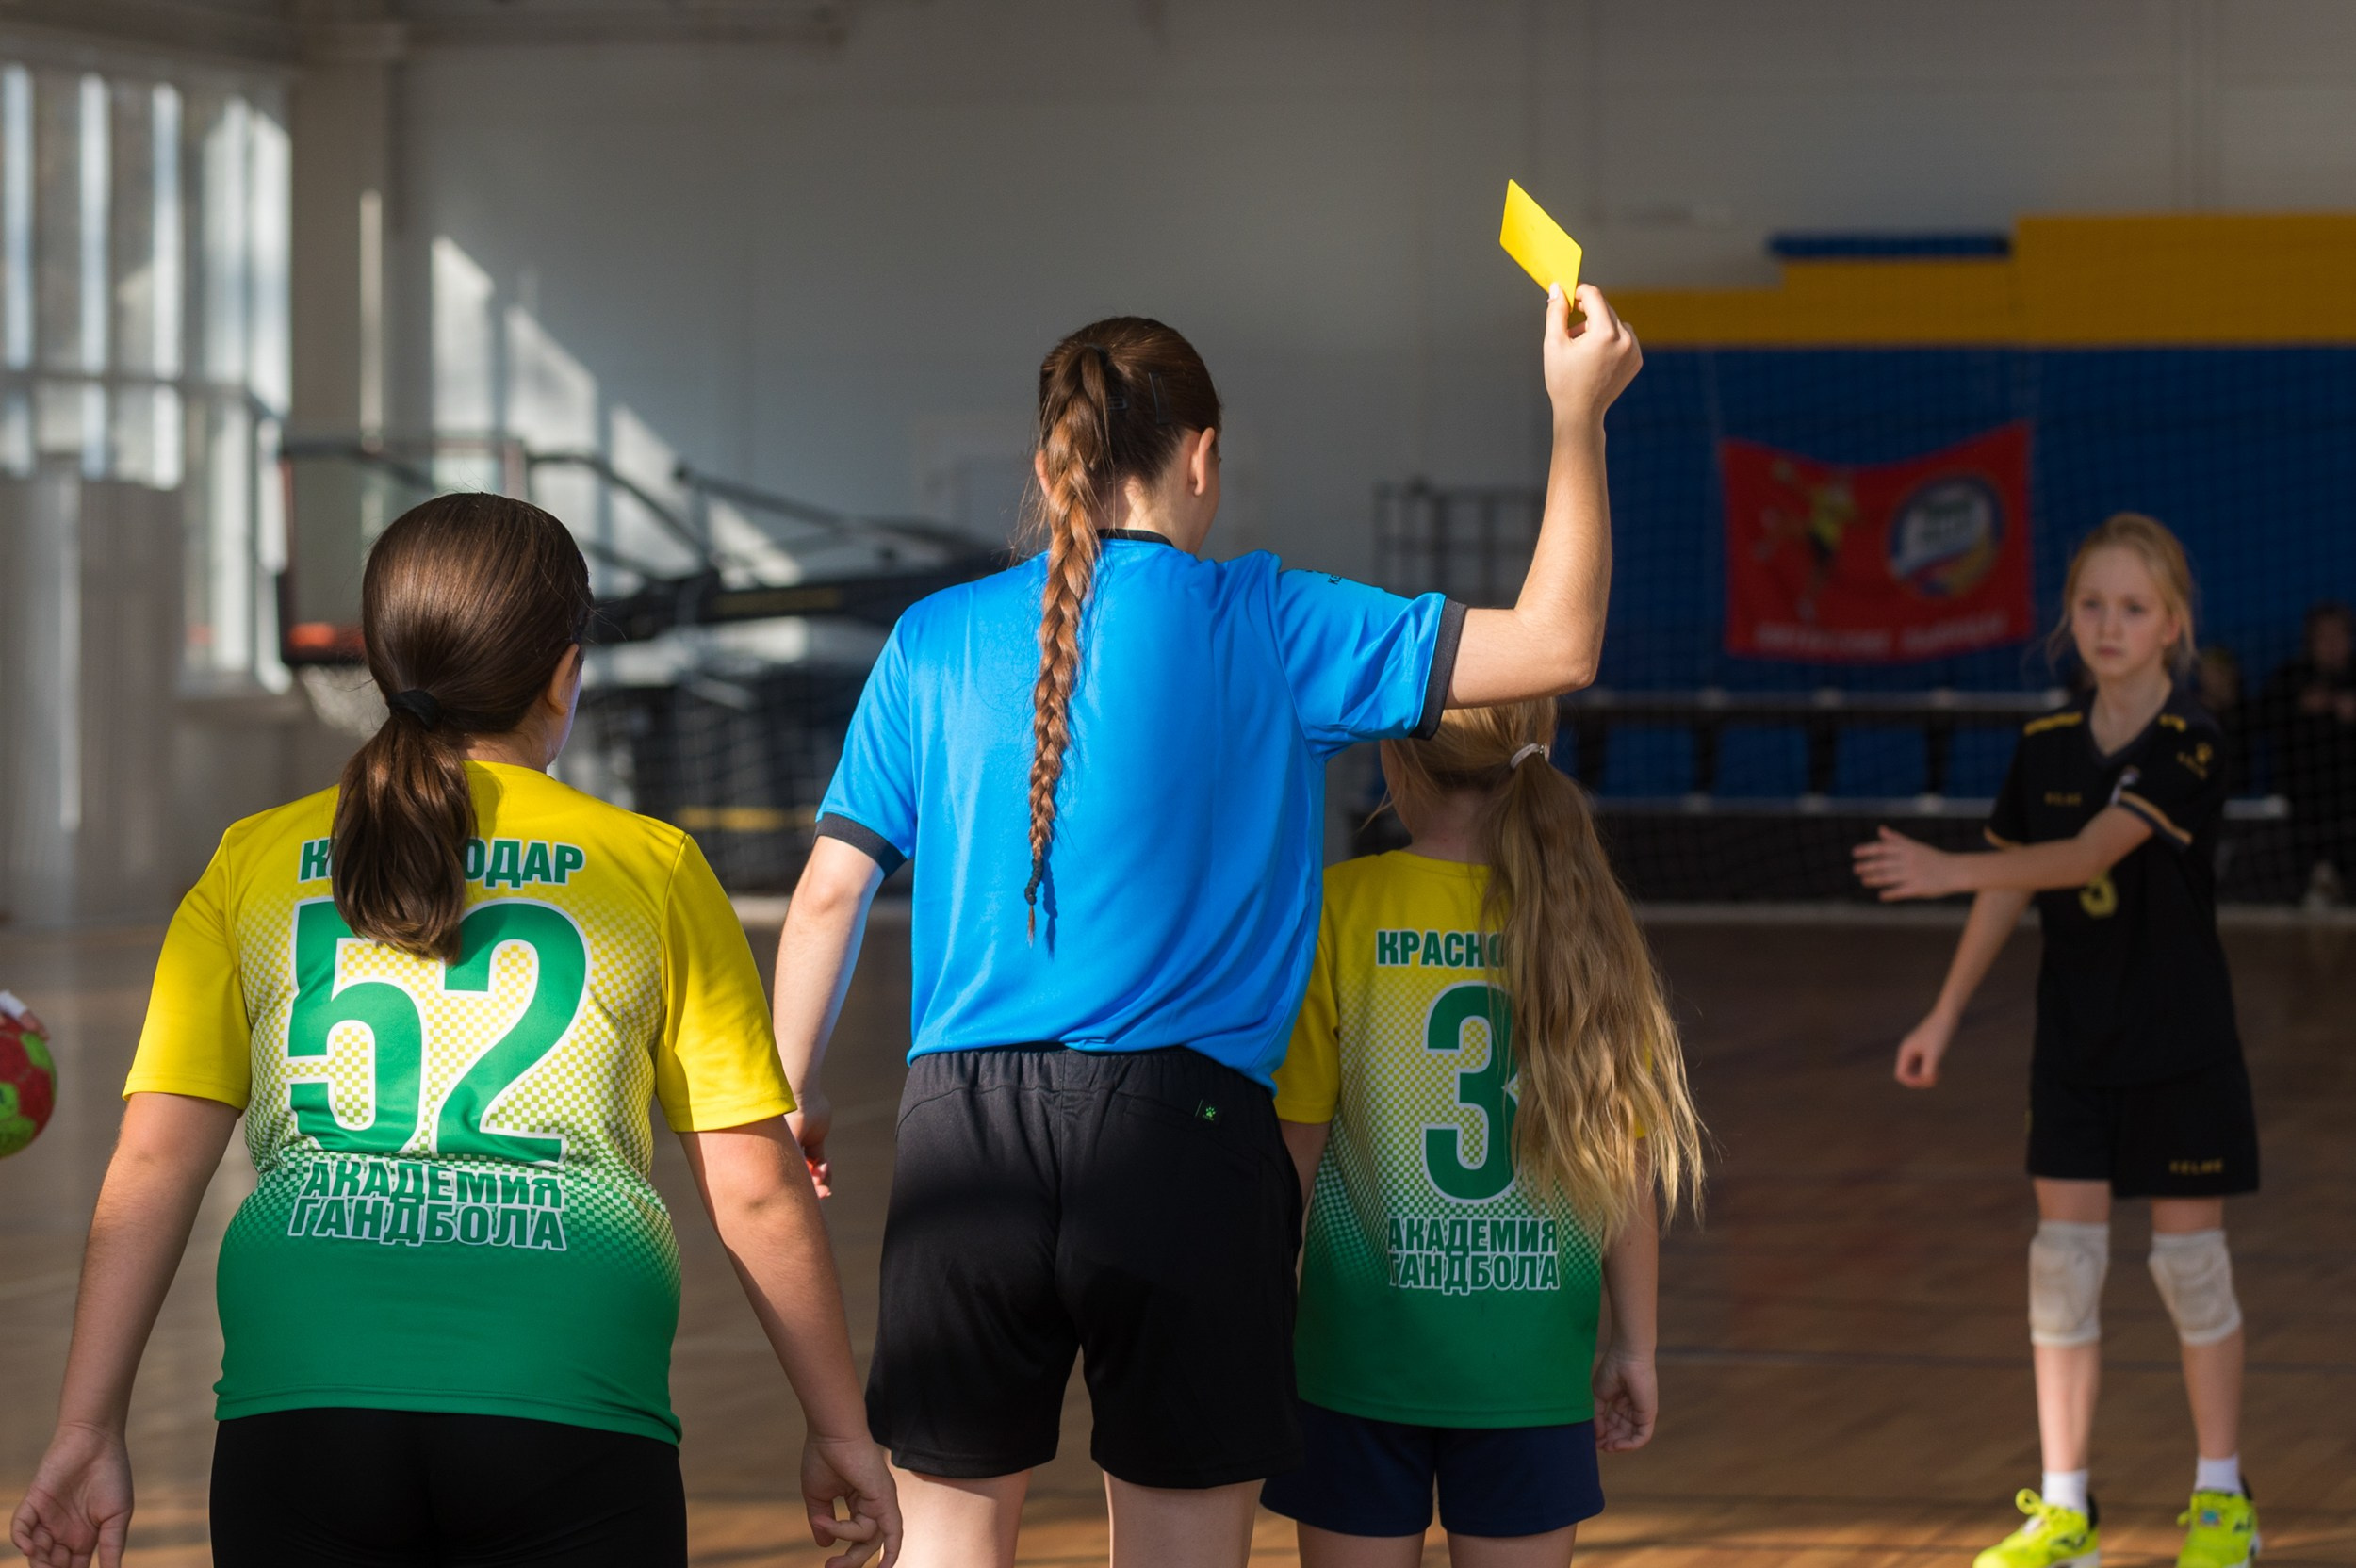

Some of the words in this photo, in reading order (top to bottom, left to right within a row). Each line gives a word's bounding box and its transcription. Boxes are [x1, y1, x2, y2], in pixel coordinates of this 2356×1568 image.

[299, 838, 584, 889] КОДАР
[1376, 929, 1516, 968] КРАСНО
[286, 898, 588, 1164] 52
[1422, 980, 1520, 1204] 3
[302, 1161, 564, 1210] АКАДЕМИЯ
[287, 1198, 566, 1252] ГАНДБОЛА
[1386, 1216, 1559, 1258] АКАДЕМИЯ
[1388, 1251, 1561, 1296] ГАНДБОЛА
